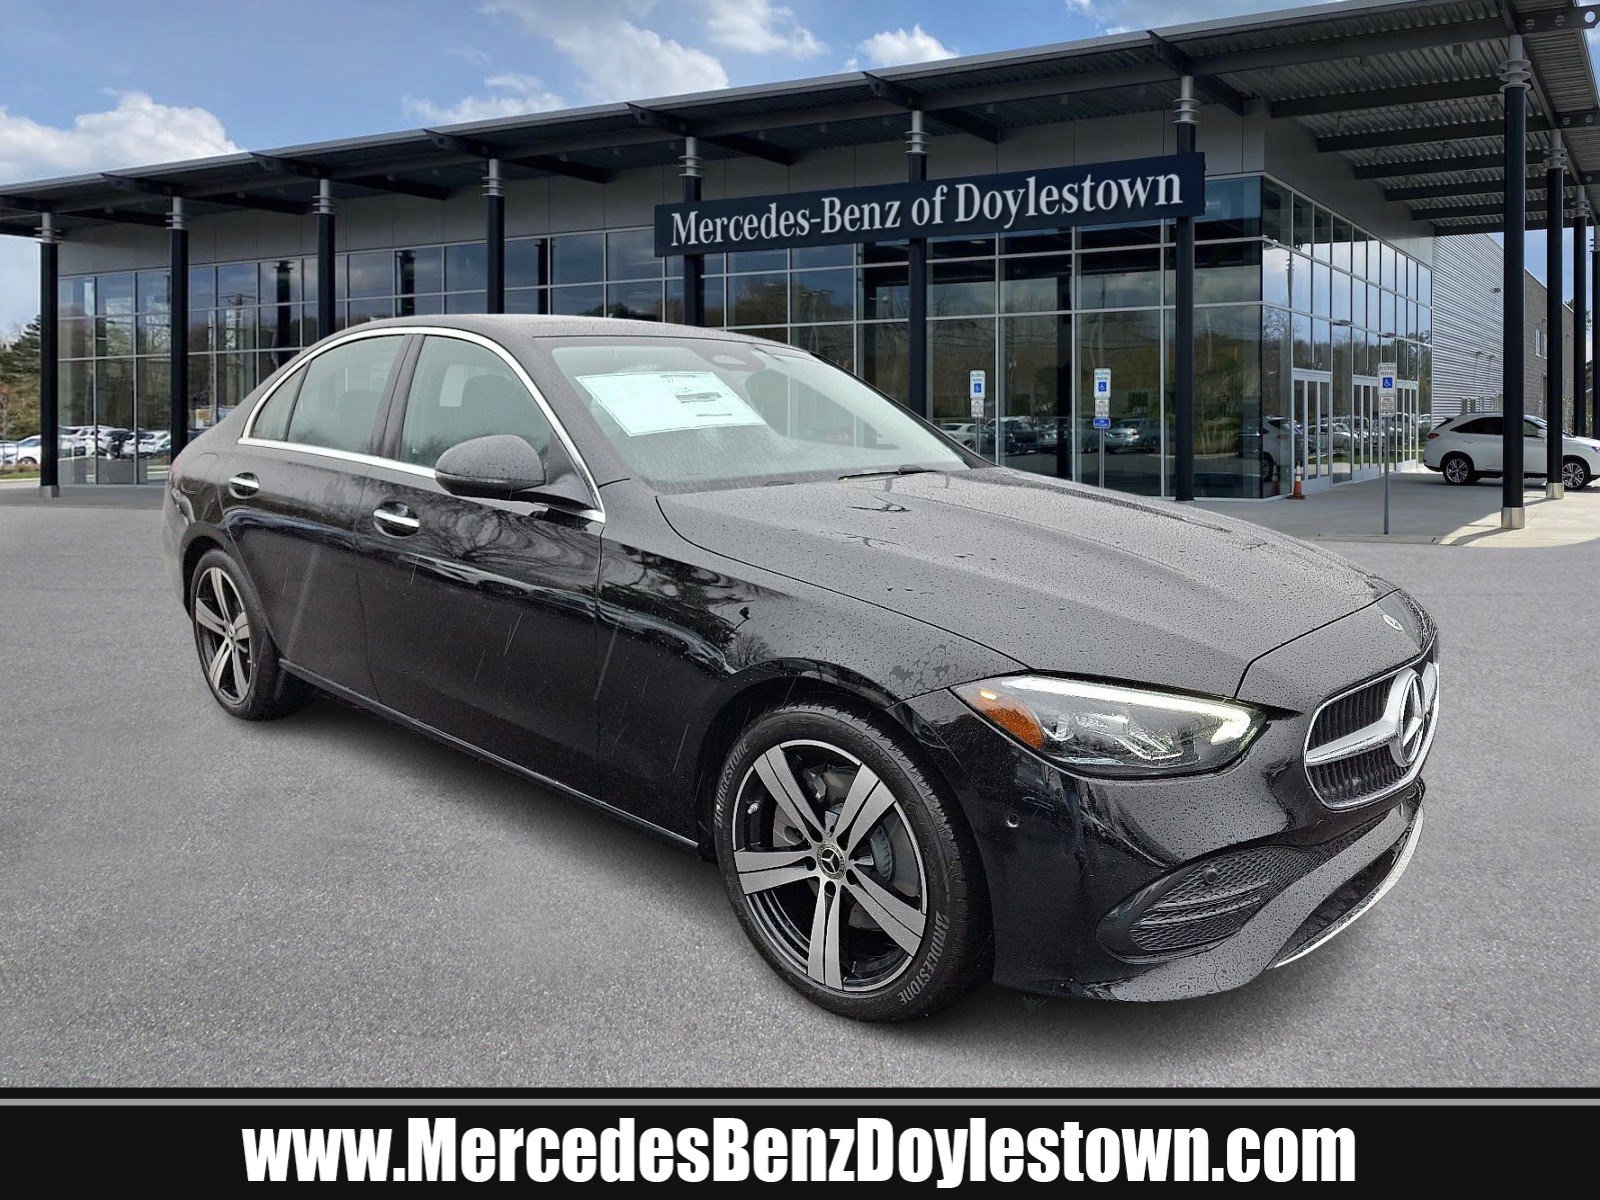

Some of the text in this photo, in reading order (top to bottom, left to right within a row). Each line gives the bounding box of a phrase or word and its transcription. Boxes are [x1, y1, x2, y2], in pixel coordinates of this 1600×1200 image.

[670, 172, 1184, 247] Mercedes-Benz of Doylestown
[897, 910, 951, 1006] BRIDGESTONE
